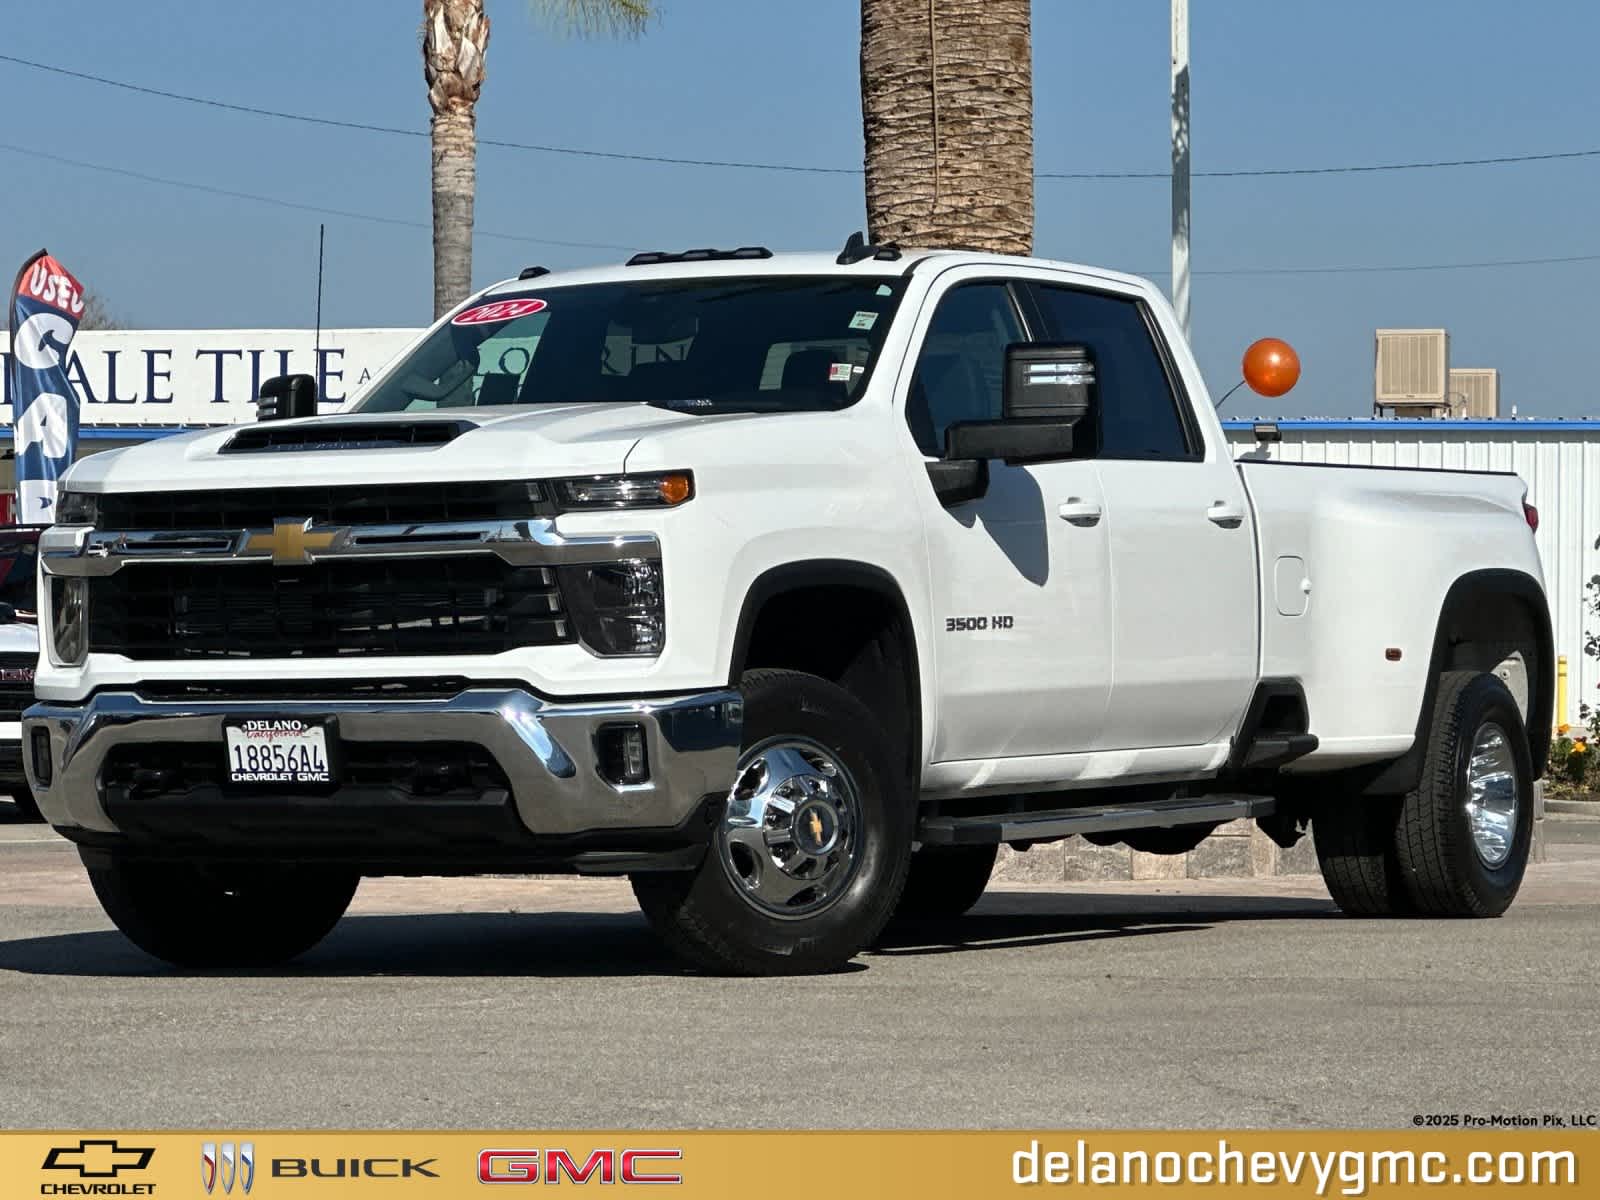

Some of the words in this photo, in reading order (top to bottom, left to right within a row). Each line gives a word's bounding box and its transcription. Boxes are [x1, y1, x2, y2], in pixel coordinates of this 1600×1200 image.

[0, 348, 174, 404] ALE
[945, 617, 988, 632] 3500
[991, 615, 1014, 629] HD
[247, 720, 302, 731] DELANO
[235, 744, 325, 773] 18856A4
[231, 773, 293, 782] CHEVROLET
[297, 772, 330, 782] GMC
